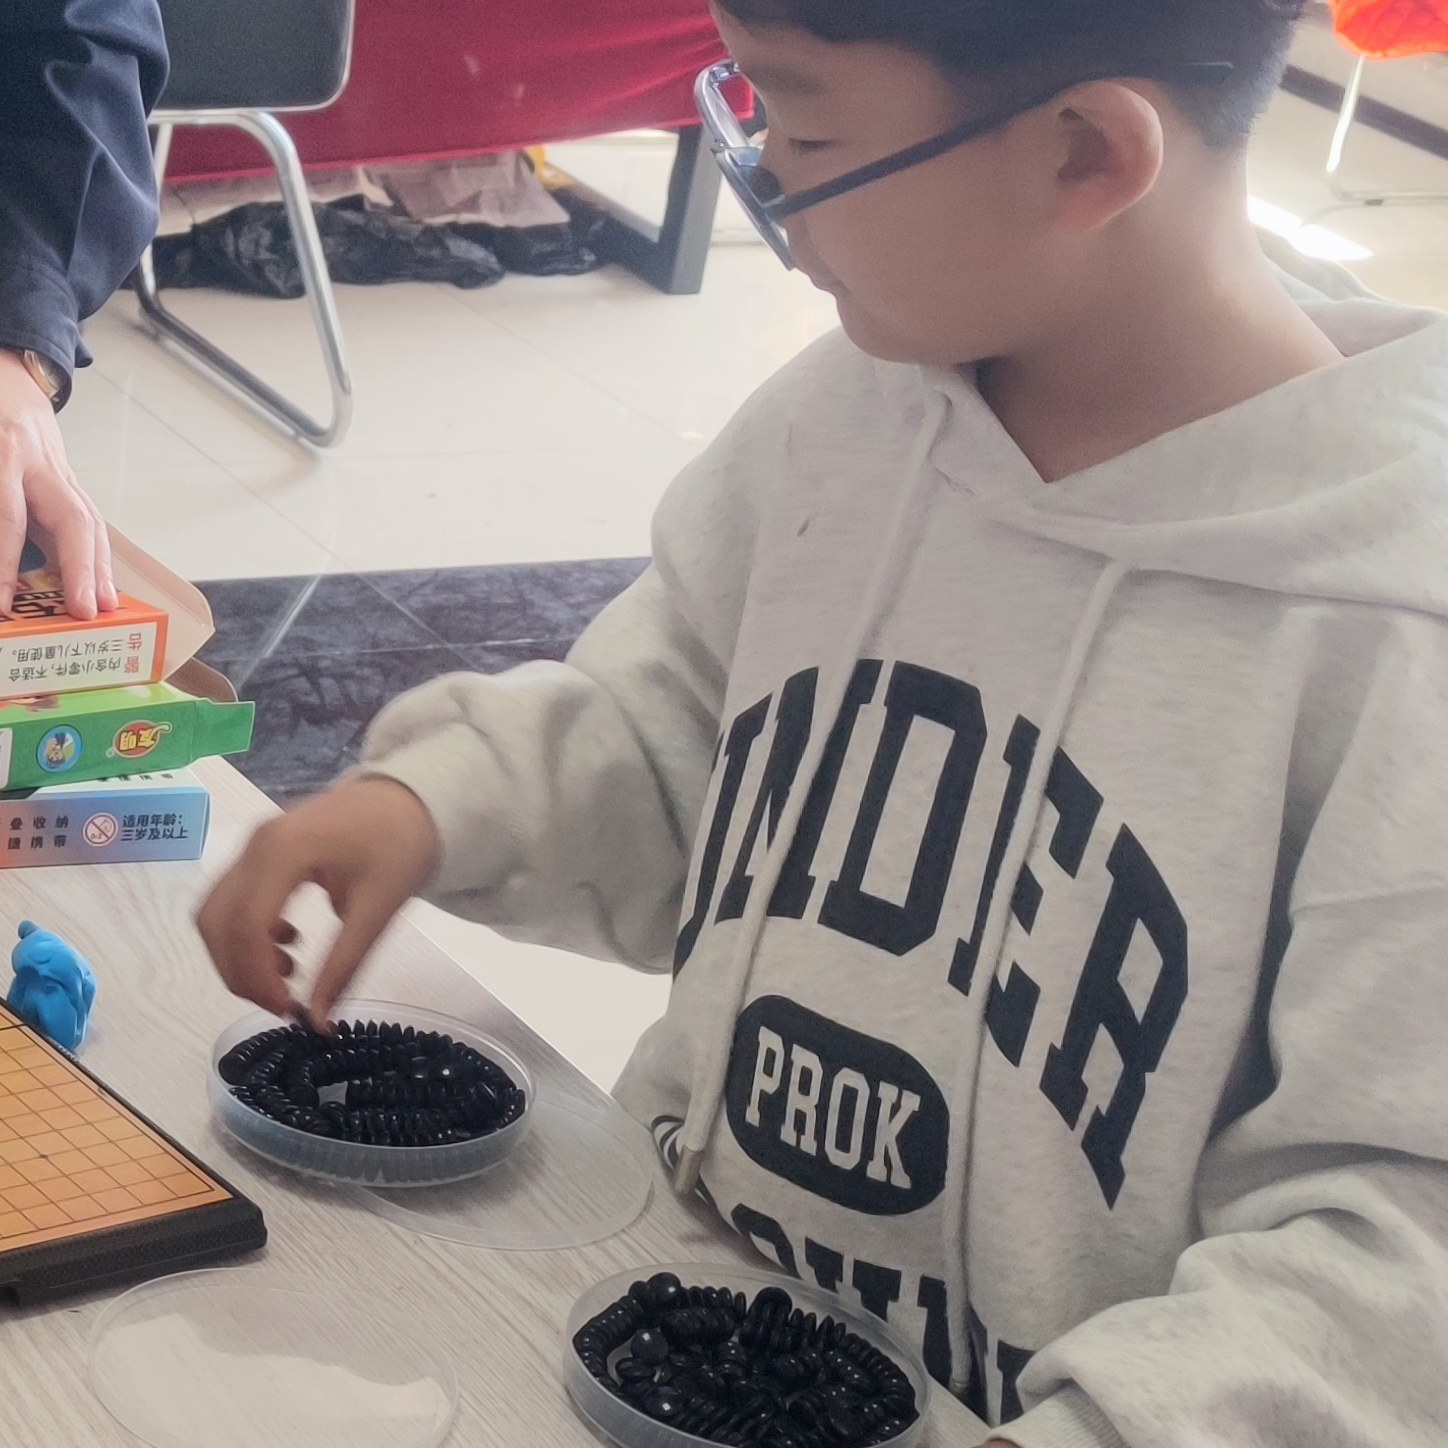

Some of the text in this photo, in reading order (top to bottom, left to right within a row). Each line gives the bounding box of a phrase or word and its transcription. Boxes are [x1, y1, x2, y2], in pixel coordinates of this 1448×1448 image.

[124, 632, 143, 674] 警告
[120, 827, 188, 842] 三岁及以上
[672, 659, 1189, 1212] NDER
[745, 1024, 922, 1191] PROK
